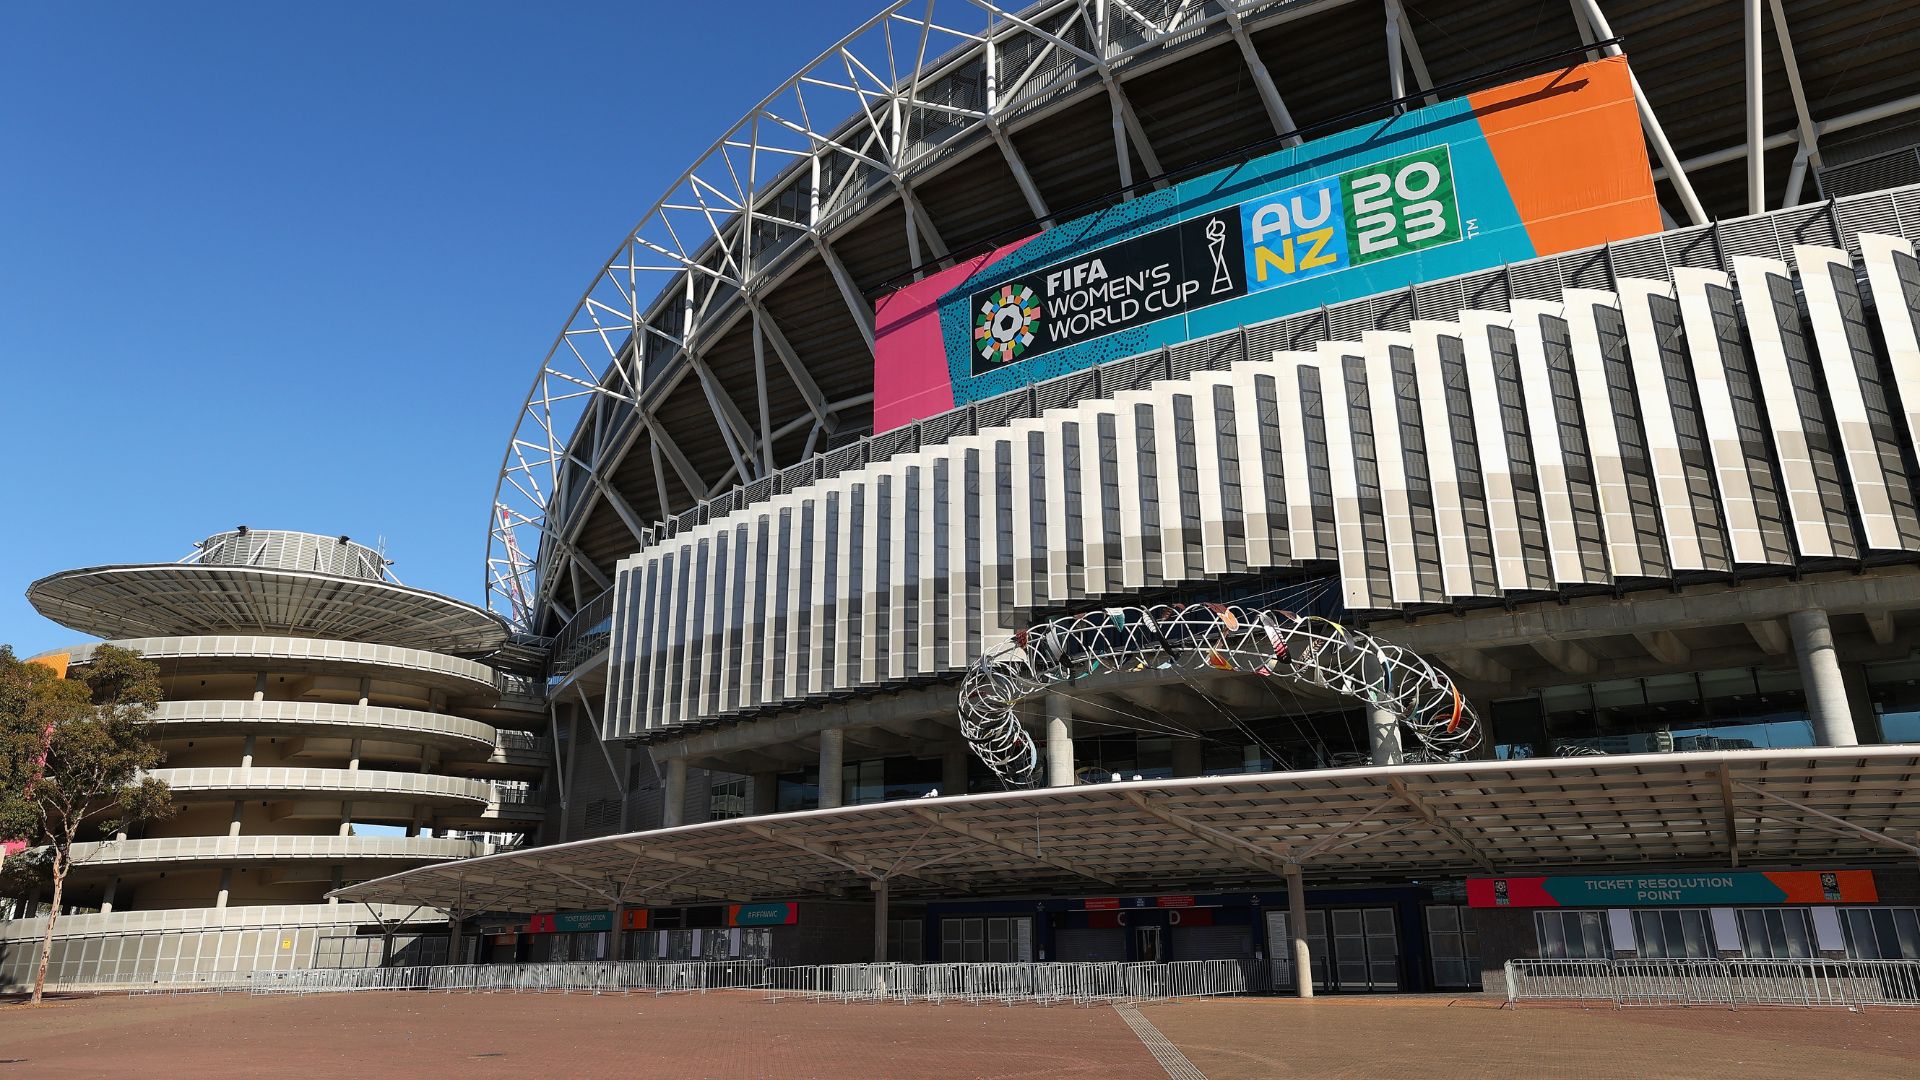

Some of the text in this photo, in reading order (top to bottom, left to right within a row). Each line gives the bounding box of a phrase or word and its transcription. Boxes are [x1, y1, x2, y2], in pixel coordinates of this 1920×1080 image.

[1351, 161, 1440, 215] 20
[1252, 188, 1332, 244] AU
[1356, 200, 1446, 255] 23
[1466, 218, 1480, 240] TM
[1047, 258, 1108, 297] FIFA
[1254, 226, 1337, 282] NZ
[1048, 263, 1171, 319] WOMEN'S
[1048, 279, 1200, 342] WORLD CUP
[1585, 877, 1733, 890] TICKET RESOLUTION
[1637, 890, 1681, 901] POINT
[1168, 910, 1181, 925] D
